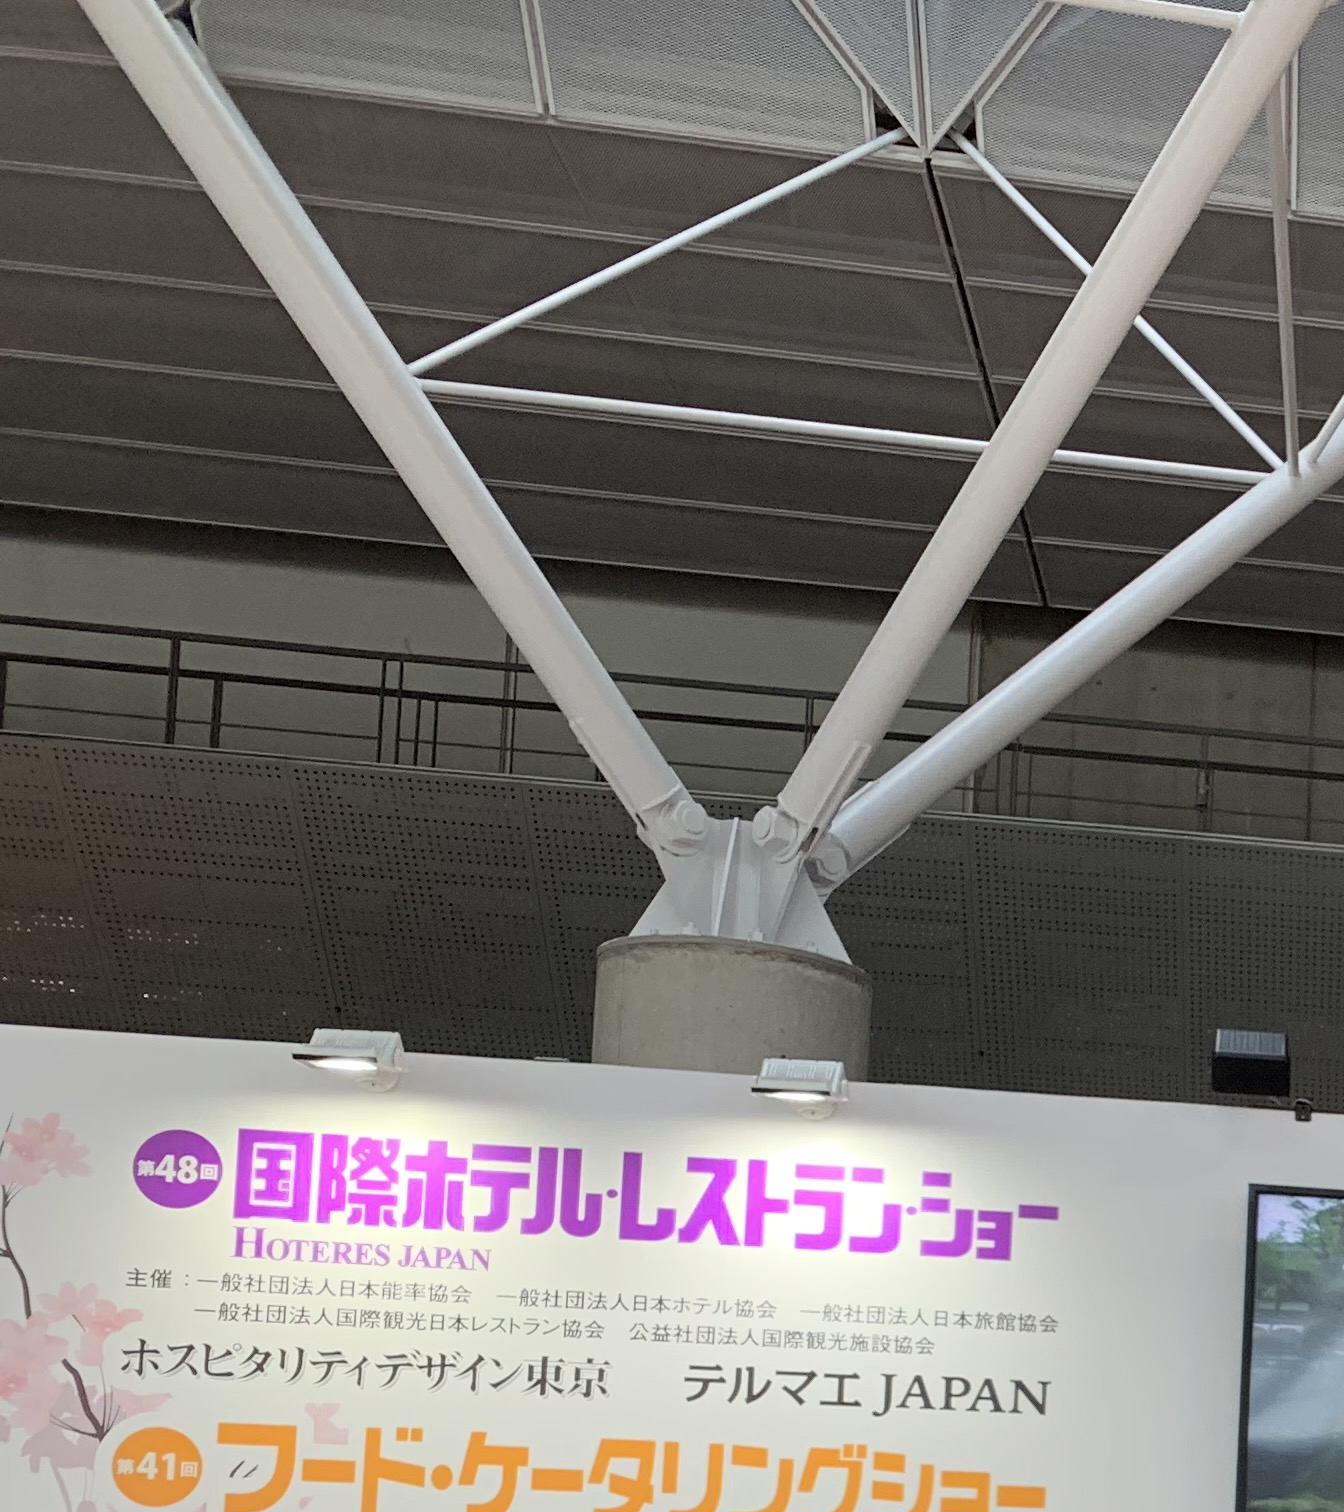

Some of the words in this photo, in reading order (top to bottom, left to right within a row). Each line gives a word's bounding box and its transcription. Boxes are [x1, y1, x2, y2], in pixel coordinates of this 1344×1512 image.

[137, 1154, 219, 1185] 第48回
[232, 1127, 1059, 1262] 国際ホテル・レストラン・ショー
[229, 1225, 391, 1267] HOTERES
[398, 1244, 492, 1272] JAPAN
[194, 1302, 606, 1340] 一般社団法人国際観光日本レストラン協会
[628, 1322, 936, 1356] 公益社団法人国際観光施設協会
[496, 1287, 777, 1320] 一般社団法人日本ホテル協会
[799, 1302, 1060, 1335] 一般社団法人日本旅館協会
[120, 1338, 610, 1399] ホスピタリティデザイン東京
[872, 1372, 1052, 1417] JAPAN
[115, 1450, 198, 1481] 第41回
